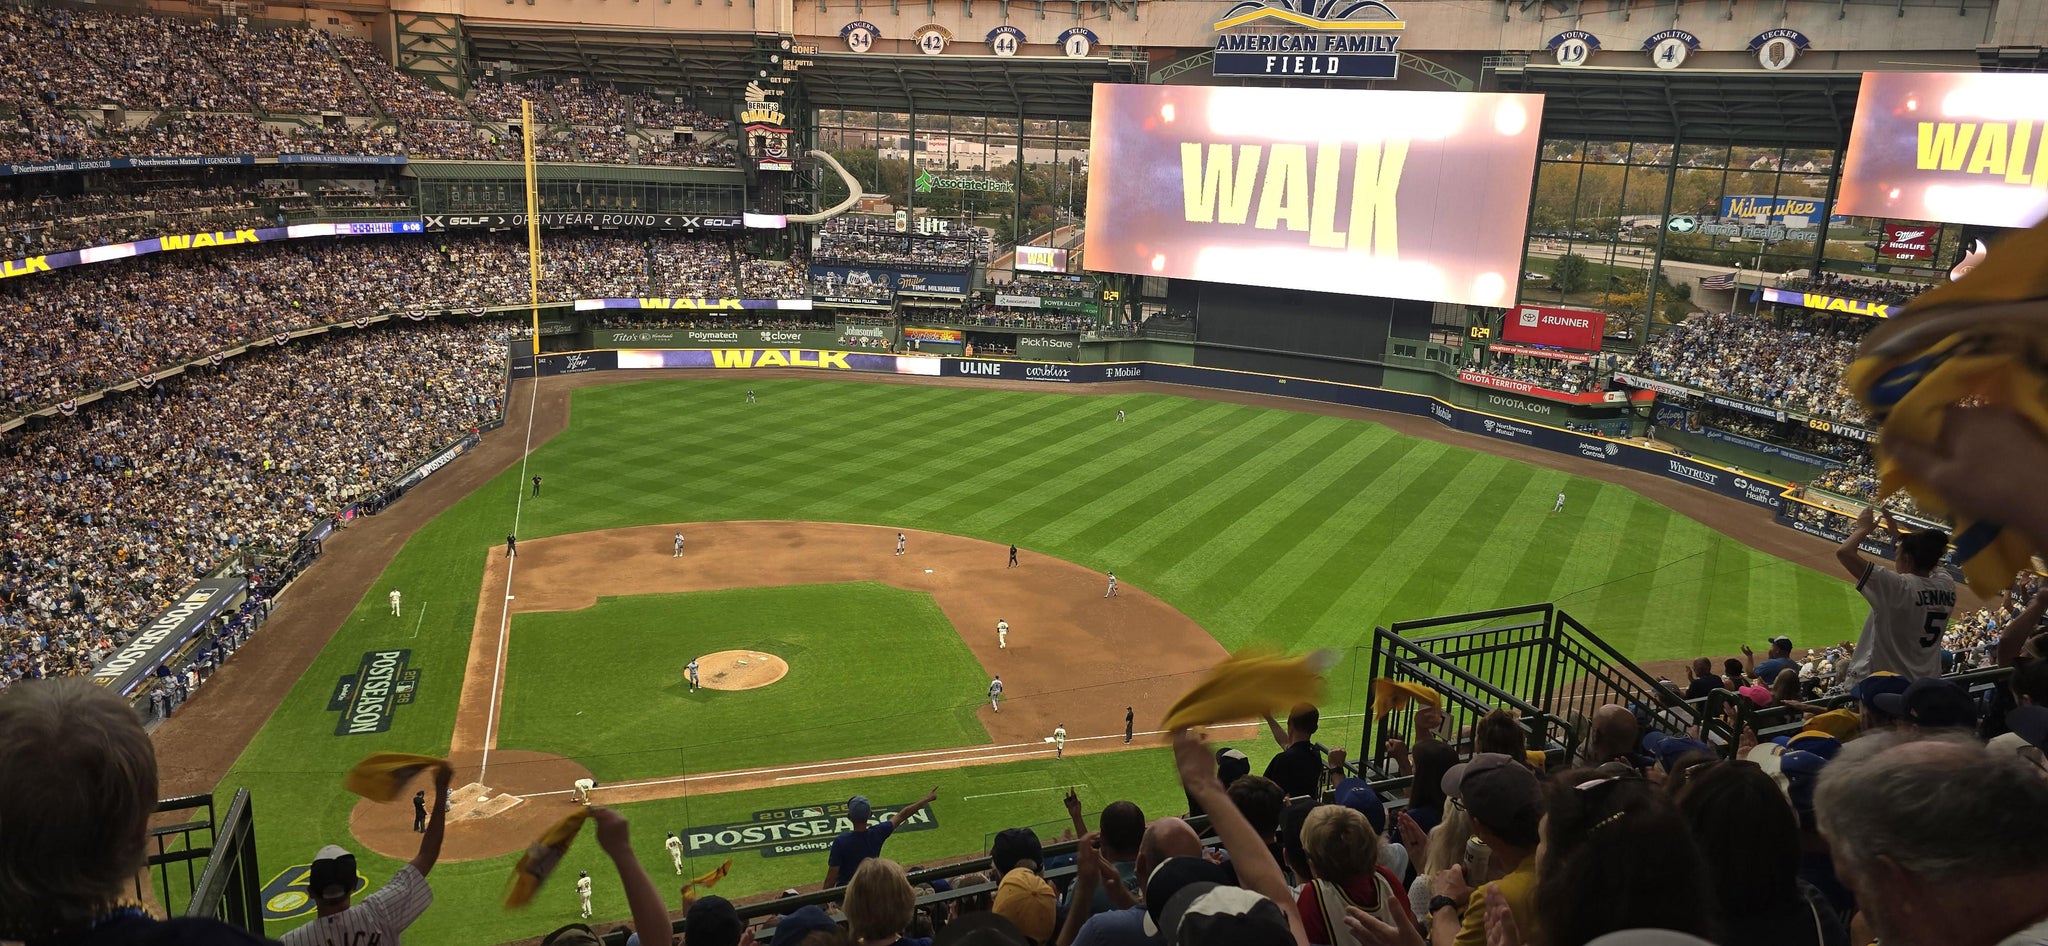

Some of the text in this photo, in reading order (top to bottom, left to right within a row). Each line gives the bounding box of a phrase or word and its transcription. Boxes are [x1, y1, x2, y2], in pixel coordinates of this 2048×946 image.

[847, 21, 875, 31] FINGERS
[917, 25, 948, 35] ROBINSON
[852, 33, 870, 46] 34
[923, 35, 940, 50] 42
[1561, 31, 1591, 41] YOUNT
[1652, 32, 1693, 43] MOLITOR
[1761, 31, 1799, 41] UECKER
[791, 46, 818, 54] GONE!
[996, 38, 1014, 52] 44
[1073, 40, 1081, 54] 1
[1216, 34, 1400, 53] AMERICAN FAMILY
[1560, 45, 1585, 62] 19
[1661, 44, 1676, 62] 4
[1265, 56, 1340, 74] FIELD
[748, 102, 778, 111] BERNIE'S
[740, 110, 785, 126] CHALET
[18, 160, 110, 173] Northwestern Mutual LEGENDS CLUB
[138, 158, 177, 166] Northwestern
[204, 157, 228, 165] LEGENDS
[932, 177, 1014, 193] Associated Bank
[1181, 139, 1411, 259] WALK
[450, 217, 489, 225] GOLF
[557, 214, 593, 225] YEAR
[602, 215, 655, 226] ROUND
[703, 218, 742, 227] GOLF
[919, 217, 948, 236] Lite
[1696, 221, 1818, 241] Aurora Health Care
[1894, 231, 1925, 242] Miller
[160, 229, 259, 251] WALK
[1027, 252, 1055, 267] WALK
[897, 277, 927, 289] Miller
[928, 285, 960, 293] MILWAUKEE
[1103, 290, 1119, 301] 0:29
[638, 298, 744, 310] WALK
[1803, 293, 1889, 318] WALK
[1542, 316, 1589, 328] 4RUNNER
[613, 332, 638, 341] Tito's
[688, 331, 738, 340] Polymatech
[771, 331, 801, 340] clover
[844, 326, 884, 338] Johnsonville
[1471, 327, 1490, 338] 0:29
[1021, 337, 1040, 346] Pick
[1049, 339, 1073, 348] Save
[711, 350, 851, 369] WALK
[960, 362, 1000, 375] ULINE
[1026, 364, 1070, 377] carbliss
[1114, 367, 1140, 377] Mobile
[1461, 373, 1533, 392] TOYOTA TERRITORY
[1488, 394, 1551, 415] TOYOTA.COM
[1714, 397, 1730, 406] GREAT
[1729, 401, 1744, 409] TASTE.
[1752, 406, 1776, 417] CALORIES.
[1435, 405, 1452, 421] Mobile
[1657, 408, 1685, 420] Culver's
[1495, 428, 1515, 437] Mutual
[1496, 422, 1532, 435] Northwestern
[1809, 418, 1866, 441] 620 WTMJ
[1579, 442, 1602, 452] Johnson
[1582, 449, 1605, 459] Controls
[426, 450, 457, 474] POSTSEASON
[1669, 460, 1718, 483] WINTRUST
[1747, 483, 1770, 496] Aurora
[1745, 491, 1779, 507] Health Ca
[1803, 526, 1819, 535] Aurora
[1820, 530, 1837, 540] Health
[1919, 611, 1948, 648] 5
[94, 601, 207, 678] POSTSEASON
[348, 651, 400, 734] POSTSEASON
[759, 811, 786, 820] 20
